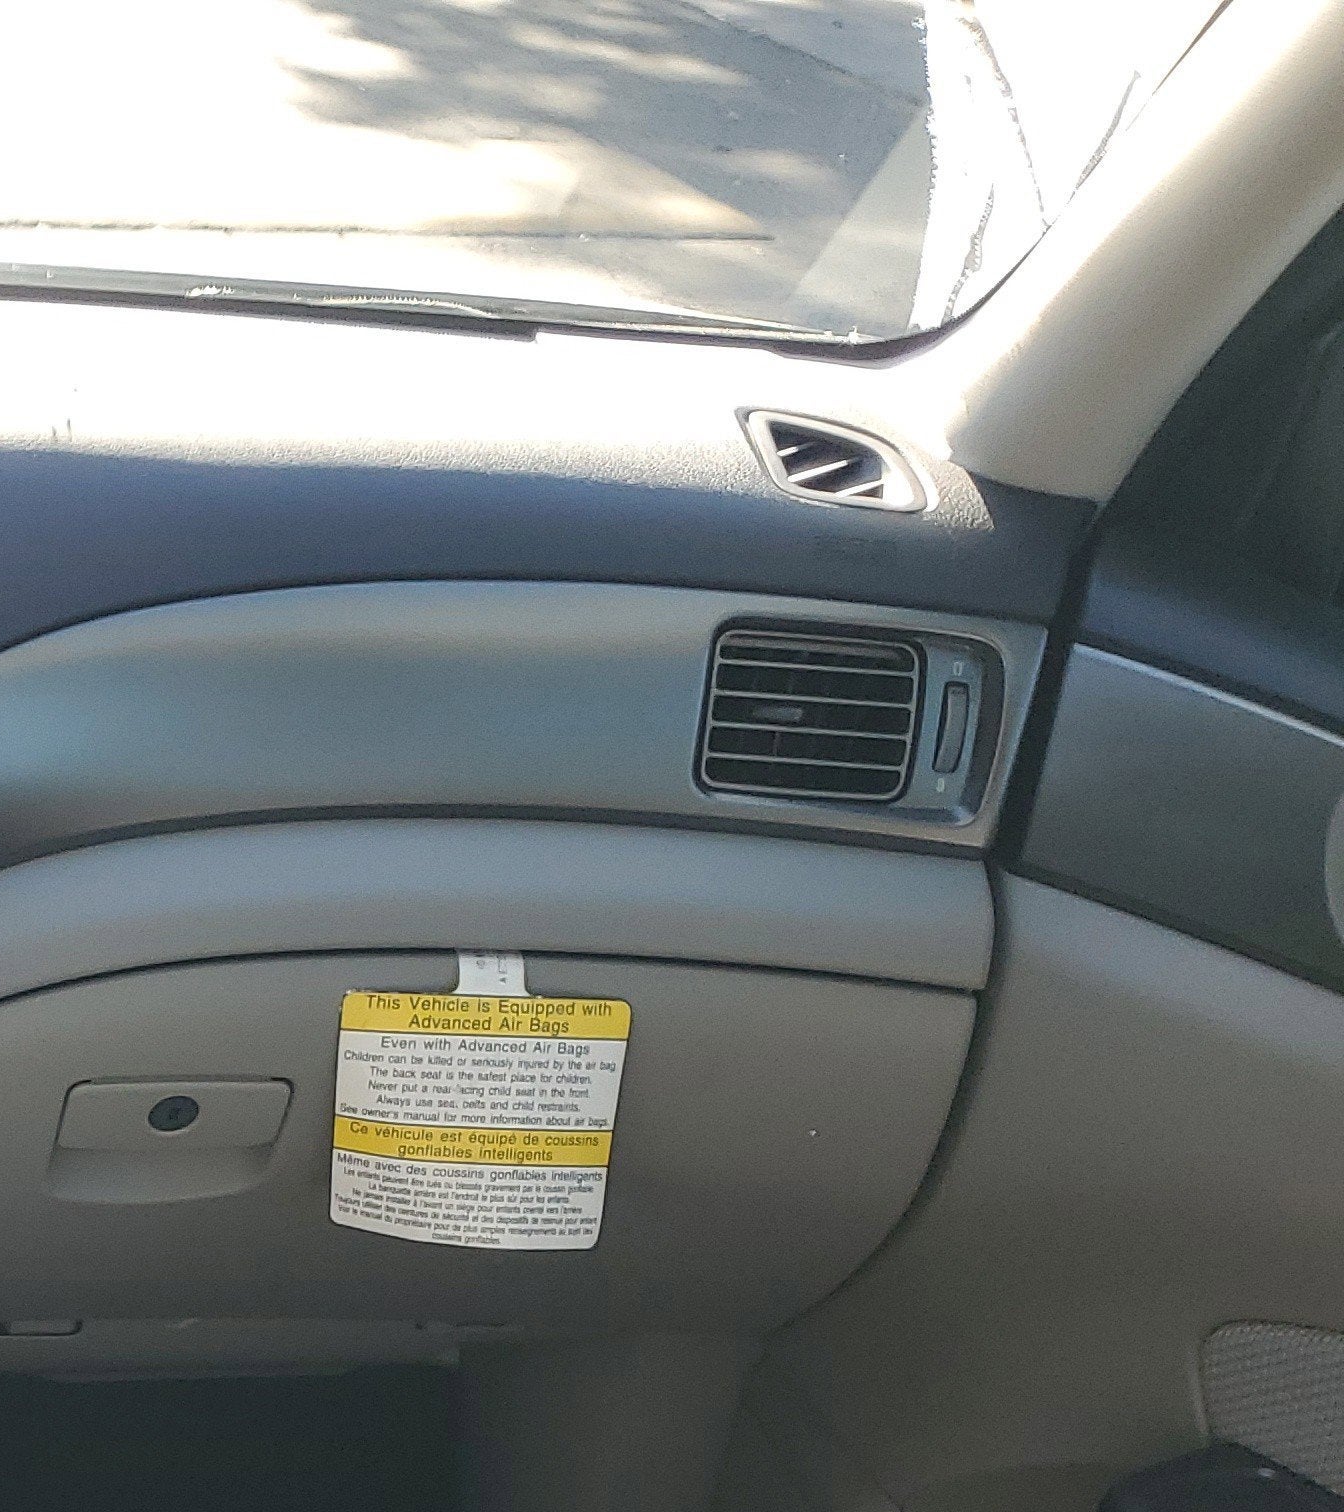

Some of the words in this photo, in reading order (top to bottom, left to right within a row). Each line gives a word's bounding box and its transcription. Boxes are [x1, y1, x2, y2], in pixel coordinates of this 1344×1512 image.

[367, 995, 400, 1009] This
[410, 996, 470, 1012] Vehicle
[478, 998, 490, 1012] is
[498, 1000, 576, 1018] Equipped
[582, 1002, 612, 1016] with
[408, 1014, 491, 1031] Advanced
[499, 1017, 523, 1031] Air
[530, 1018, 570, 1036] Bags
[381, 1036, 416, 1049] Even
[424, 1038, 450, 1050] with
[458, 1039, 527, 1052] Advanced
[533, 1042, 551, 1054] Air
[558, 1042, 590, 1058] Bags
[344, 1050, 384, 1062] Children
[388, 1055, 406, 1064] can
[411, 1056, 423, 1064] be
[428, 1056, 453, 1066] killed
[471, 1058, 513, 1068] seriously
[553, 1060, 565, 1070] by
[568, 1060, 583, 1069] the
[370, 1066, 388, 1076] The
[392, 1068, 416, 1078] back
[420, 1069, 442, 1079] seat
[446, 1070, 454, 1079] is
[458, 1071, 474, 1080] the
[478, 1071, 506, 1081] safest
[510, 1073, 536, 1083] place
[540, 1074, 552, 1083] for
[368, 1079, 398, 1091] Never
[401, 1082, 418, 1093] put
[488, 1086, 511, 1096] child
[551, 1088, 566, 1097] the
[376, 1094, 411, 1107] Always
[416, 1098, 433, 1106] use
[490, 1100, 509, 1109] and
[513, 1101, 535, 1111] child
[403, 1111, 440, 1121] manual
[444, 1111, 457, 1121] for
[461, 1112, 486, 1122] more
[490, 1114, 542, 1125] information
[546, 1115, 571, 1126] about
[350, 1121, 368, 1134] Ce
[375, 1126, 434, 1141] véhicule
[440, 1131, 462, 1142] est
[468, 1132, 517, 1146] équipé
[523, 1133, 538, 1145] de
[545, 1135, 599, 1146] coussins
[398, 1144, 472, 1158] gonflables
[479, 1147, 553, 1163] intelligents
[337, 1153, 370, 1168] Même
[375, 1161, 401, 1173] avec
[406, 1164, 427, 1176] des
[433, 1168, 484, 1178] coussins
[490, 1170, 547, 1181] gonflables
[551, 1171, 603, 1184] intelligents
